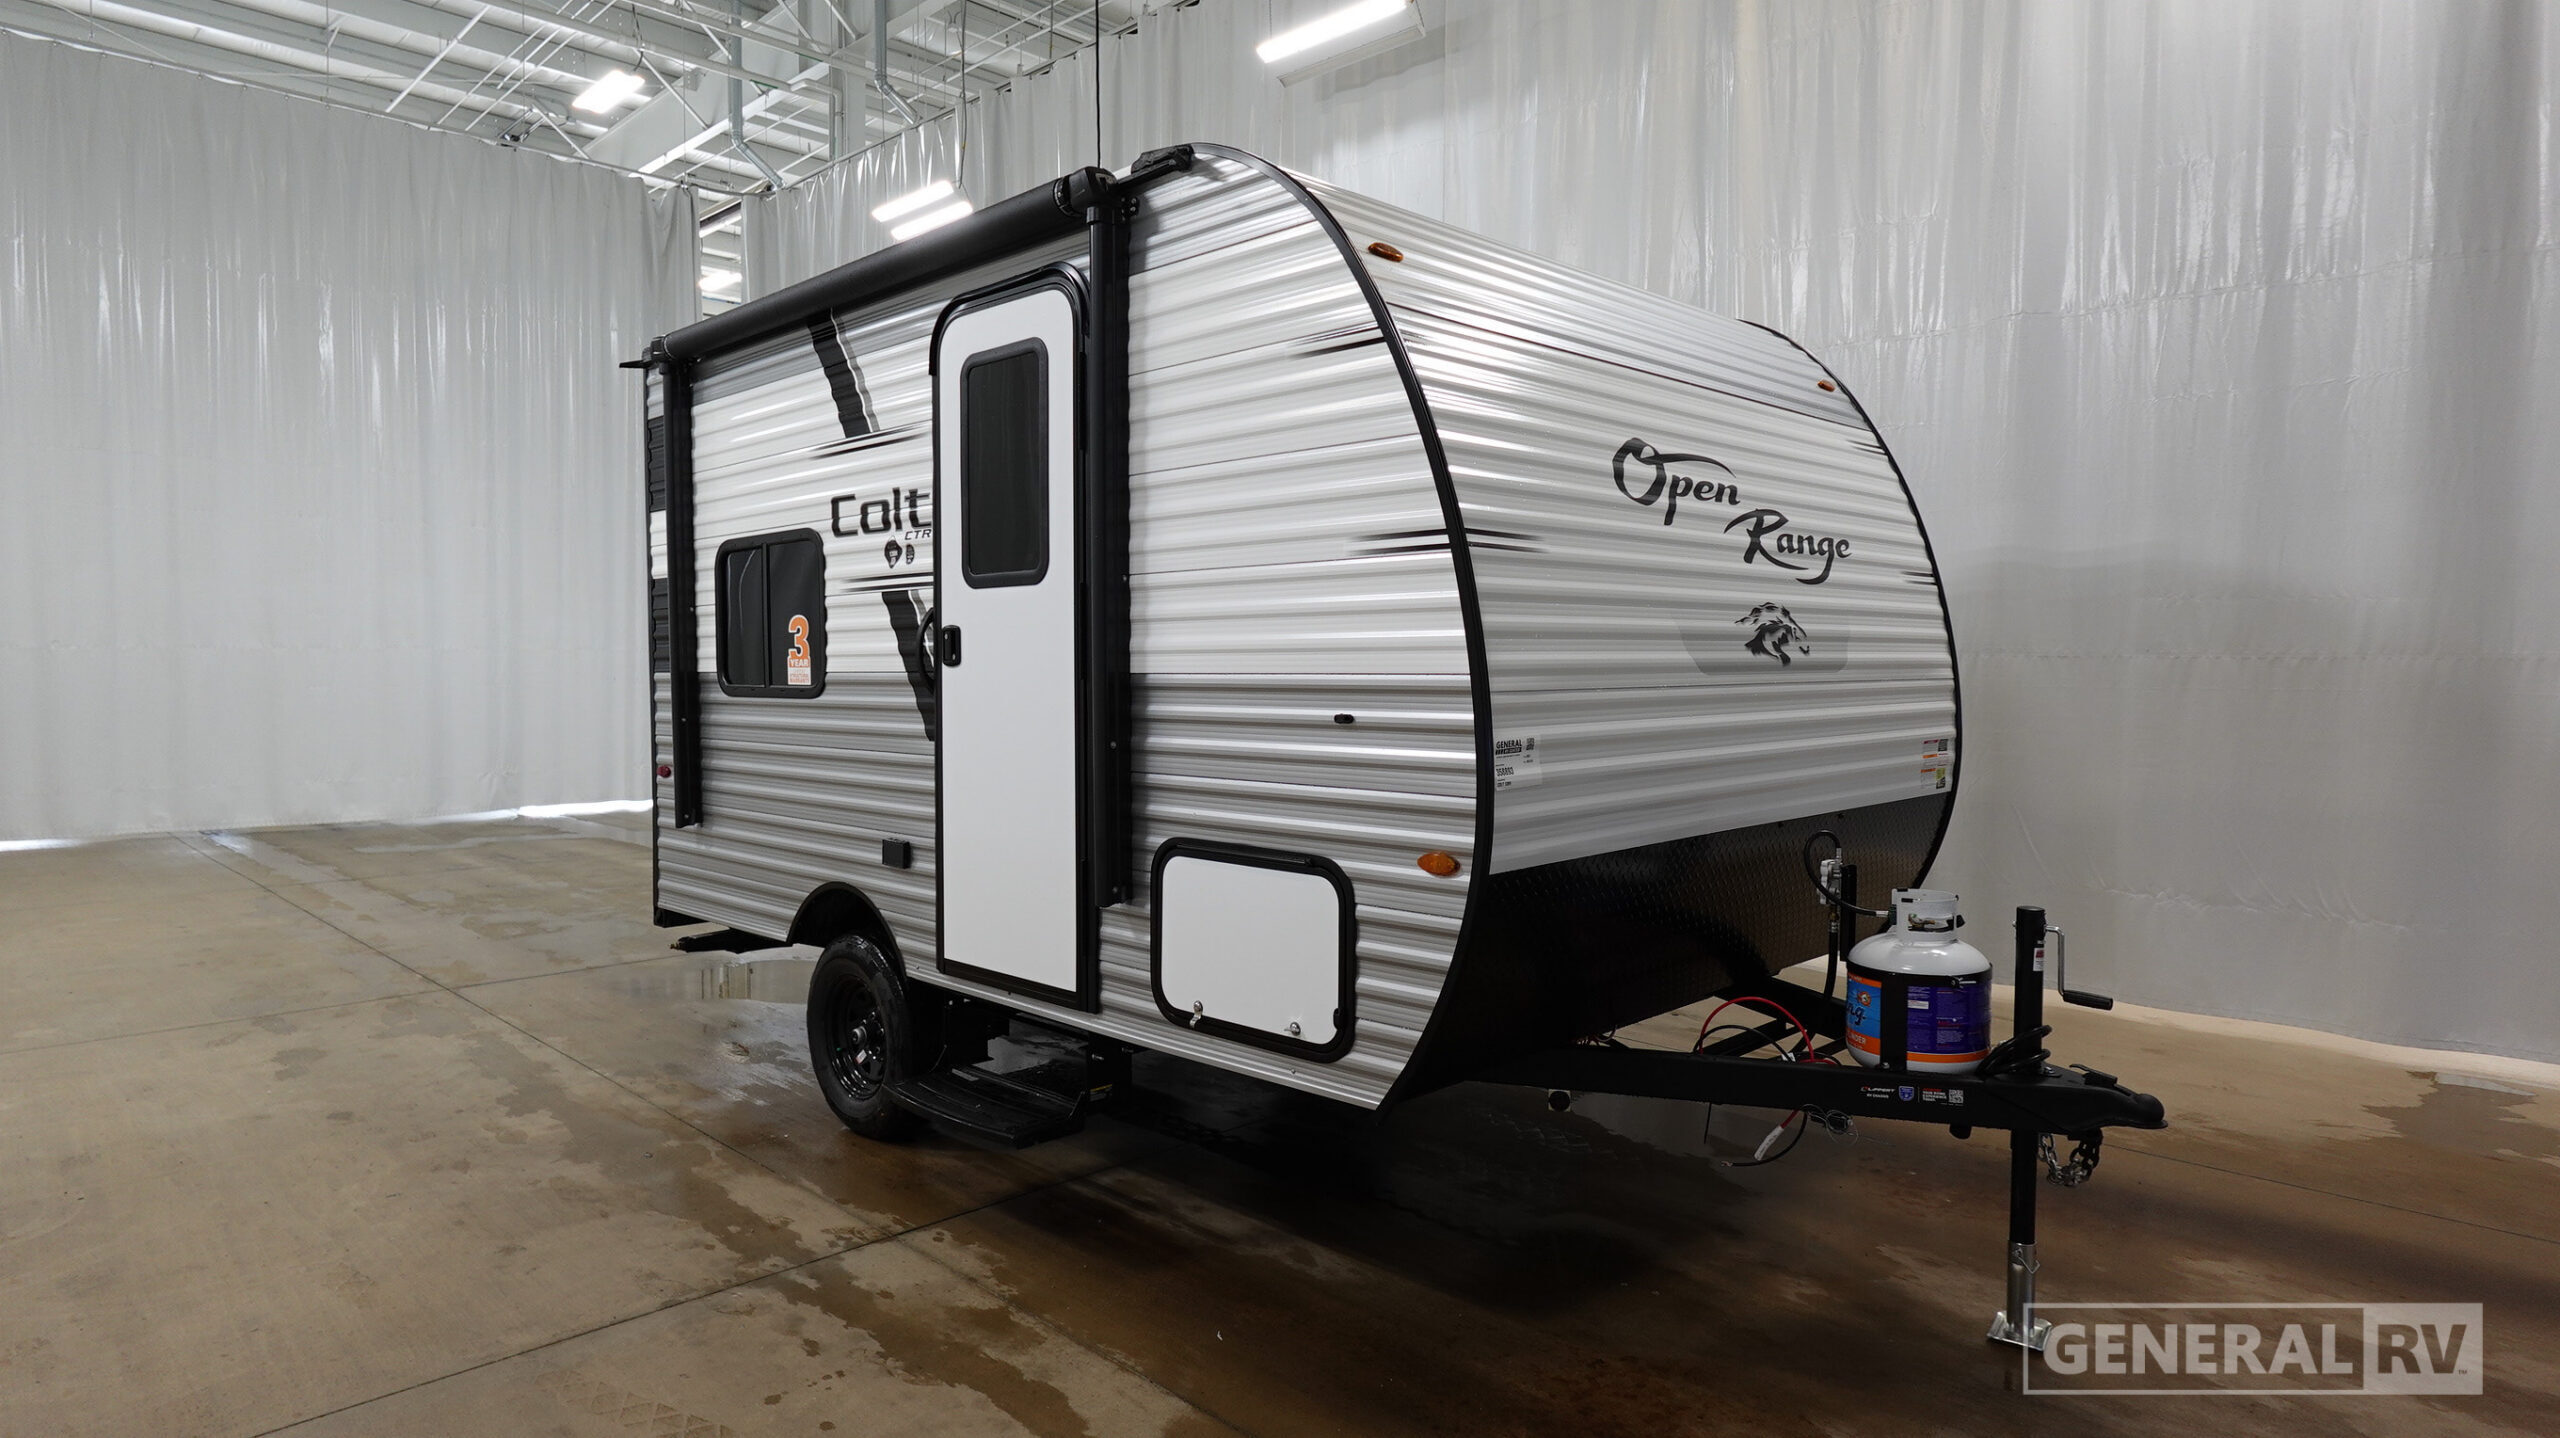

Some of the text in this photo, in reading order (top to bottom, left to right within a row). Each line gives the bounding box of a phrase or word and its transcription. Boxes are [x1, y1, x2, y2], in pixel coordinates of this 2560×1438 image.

[1612, 437, 1741, 526] Open
[831, 487, 931, 538] Colt
[904, 529, 932, 541] CTR
[1723, 508, 1852, 585] Range
[788, 615, 810, 660] 3
[789, 658, 809, 668] YEAR
[1496, 739, 1522, 749] GENERAL
